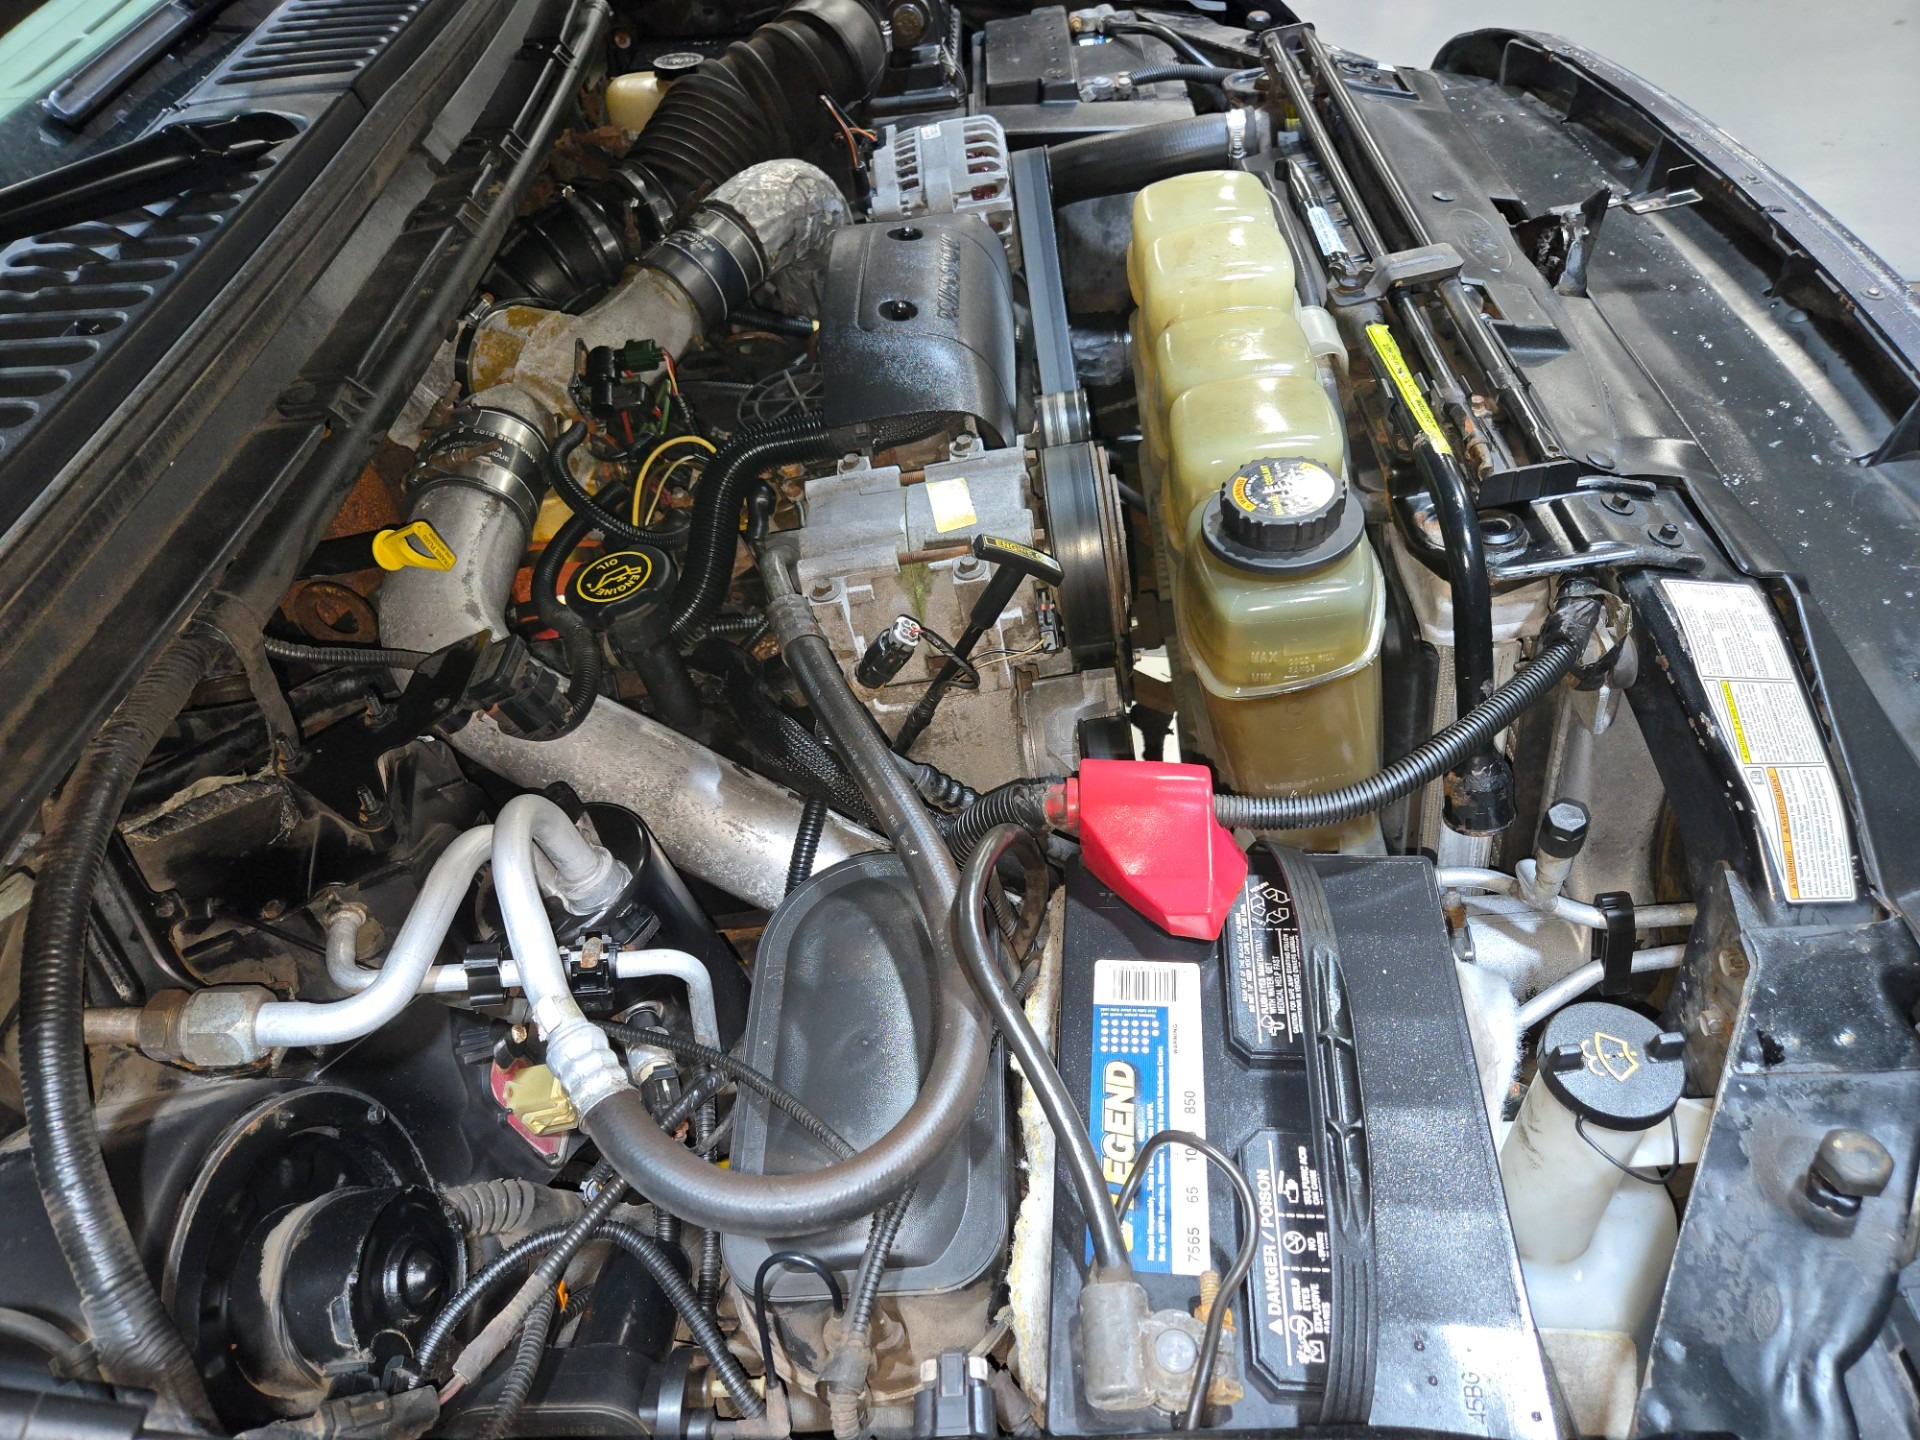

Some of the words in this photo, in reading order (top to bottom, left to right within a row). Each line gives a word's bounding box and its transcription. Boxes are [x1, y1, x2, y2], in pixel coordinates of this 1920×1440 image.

[1234, 480, 1247, 503] WARNING
[995, 539, 1033, 558] ENGINE
[597, 558, 618, 570] OIL
[595, 574, 640, 596] ENGINE
[1251, 652, 1278, 663] MAX
[1288, 657, 1309, 665] COLD
[1251, 672, 1271, 682] MIN
[1771, 775, 1788, 826] AVERTISSEMENT
[1785, 851, 1796, 882] WARNING
[1242, 929, 1250, 941] TIGHT
[1283, 934, 1291, 951] FOLLOW
[1237, 943, 1245, 958] REACH
[1243, 942, 1251, 955] CAPS
[1256, 940, 1266, 976] IMMEDIATELY
[1273, 955, 1281, 969] FAST
[1285, 952, 1293, 973] STARTING
[1265, 962, 1273, 973] GET
[1259, 978, 1267, 993] EYES
[1274, 971, 1283, 986] HELP
[1276, 988, 1286, 1014] MEDICAL
[1288, 989, 1296, 1000] SAFE
[1260, 995, 1269, 1014] FLUSH
[1268, 999, 1277, 1014] WITH
[1289, 1001, 1297, 1011] FOR
[1183, 1091, 1197, 1114] 850
[1298, 1146, 1308, 1164] ACID
[1300, 1166, 1312, 1205] SULFURIC
[1185, 1187, 1199, 1203] 65
[1257, 1169, 1274, 1228] POISON
[1187, 1227, 1201, 1262] 7565
[1262, 1231, 1275, 1242] /
[1308, 1238, 1317, 1251] NO
[1263, 1245, 1282, 1315] DANGER
[1301, 1287, 1311, 1311] EYES
[1311, 1284, 1324, 1333] EXPLOSIVE
[1461, 1372, 1486, 1424] 45BG
